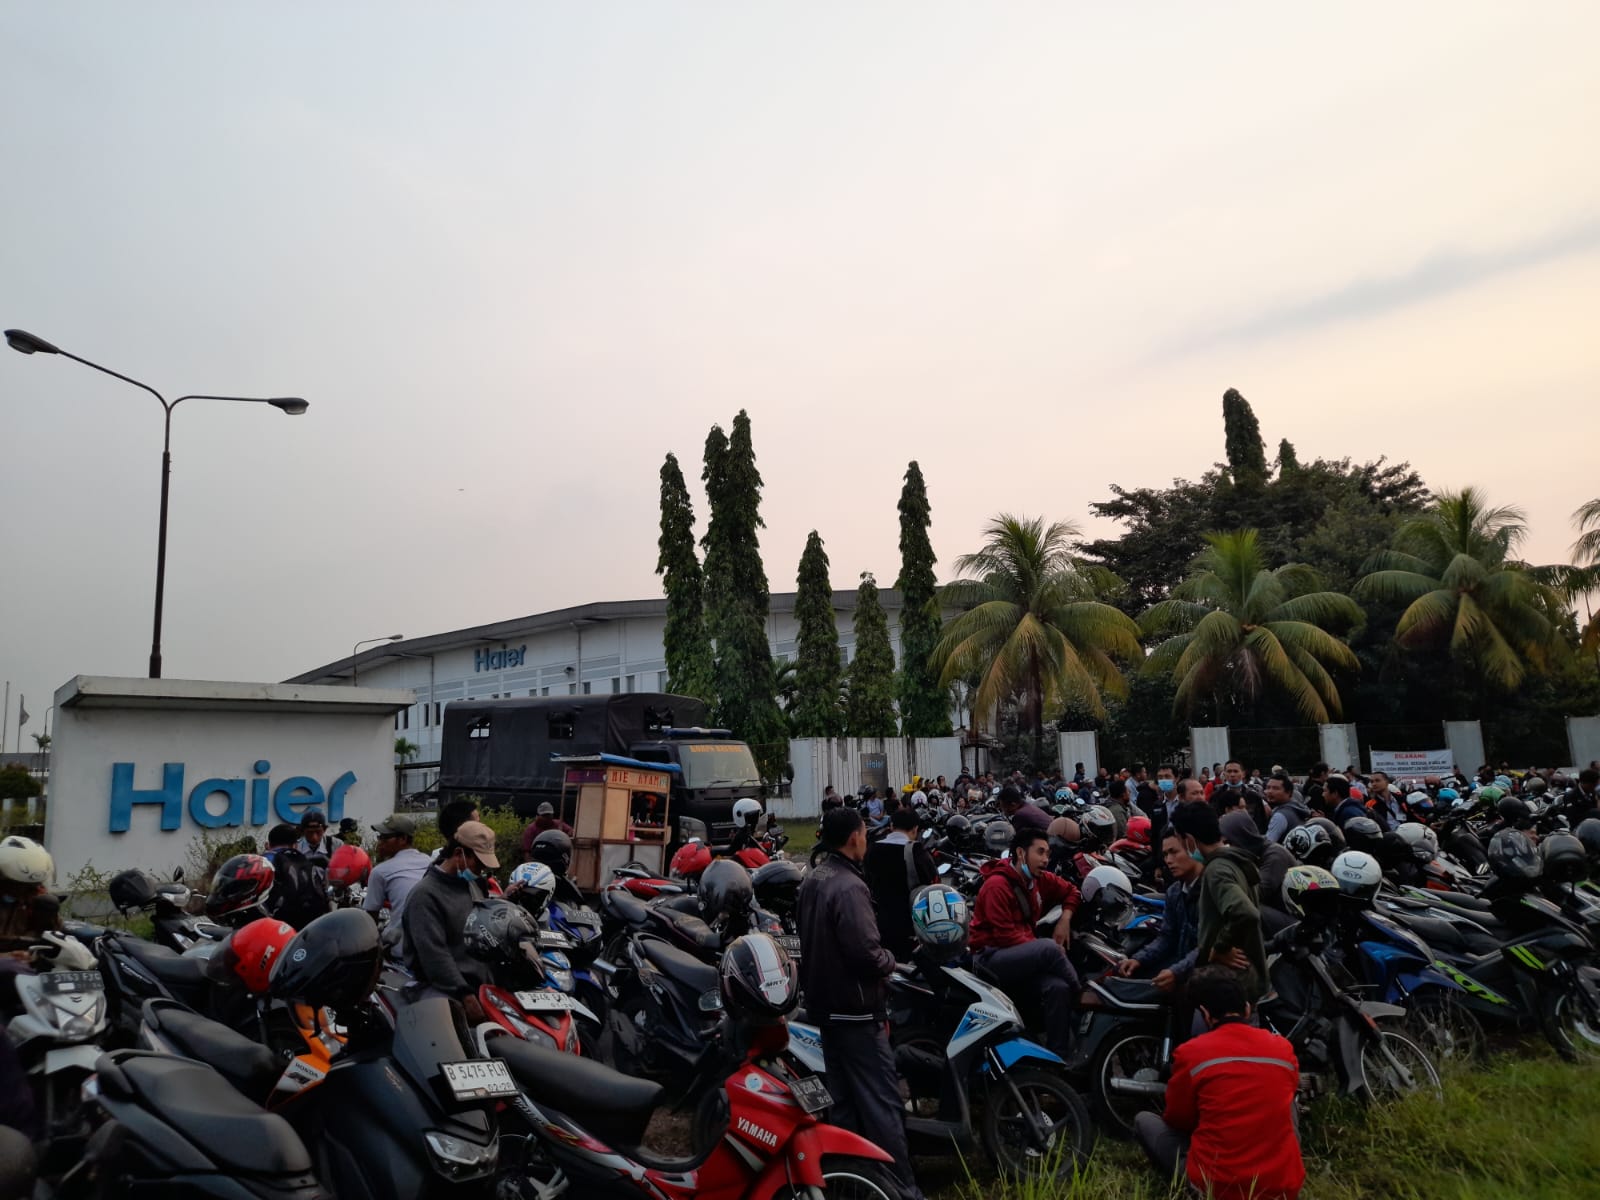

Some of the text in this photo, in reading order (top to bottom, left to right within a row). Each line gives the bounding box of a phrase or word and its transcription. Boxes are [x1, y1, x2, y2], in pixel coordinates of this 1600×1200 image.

[474, 644, 526, 672] Haier
[611, 770, 659, 786] MIE AYAM
[109, 760, 357, 832] Haier
[974, 1008, 998, 1018] HONDA
[295, 1063, 318, 1077] HONDA
[447, 1063, 507, 1080] B 5475 FLH
[737, 1117, 778, 1147] YAMAHA
